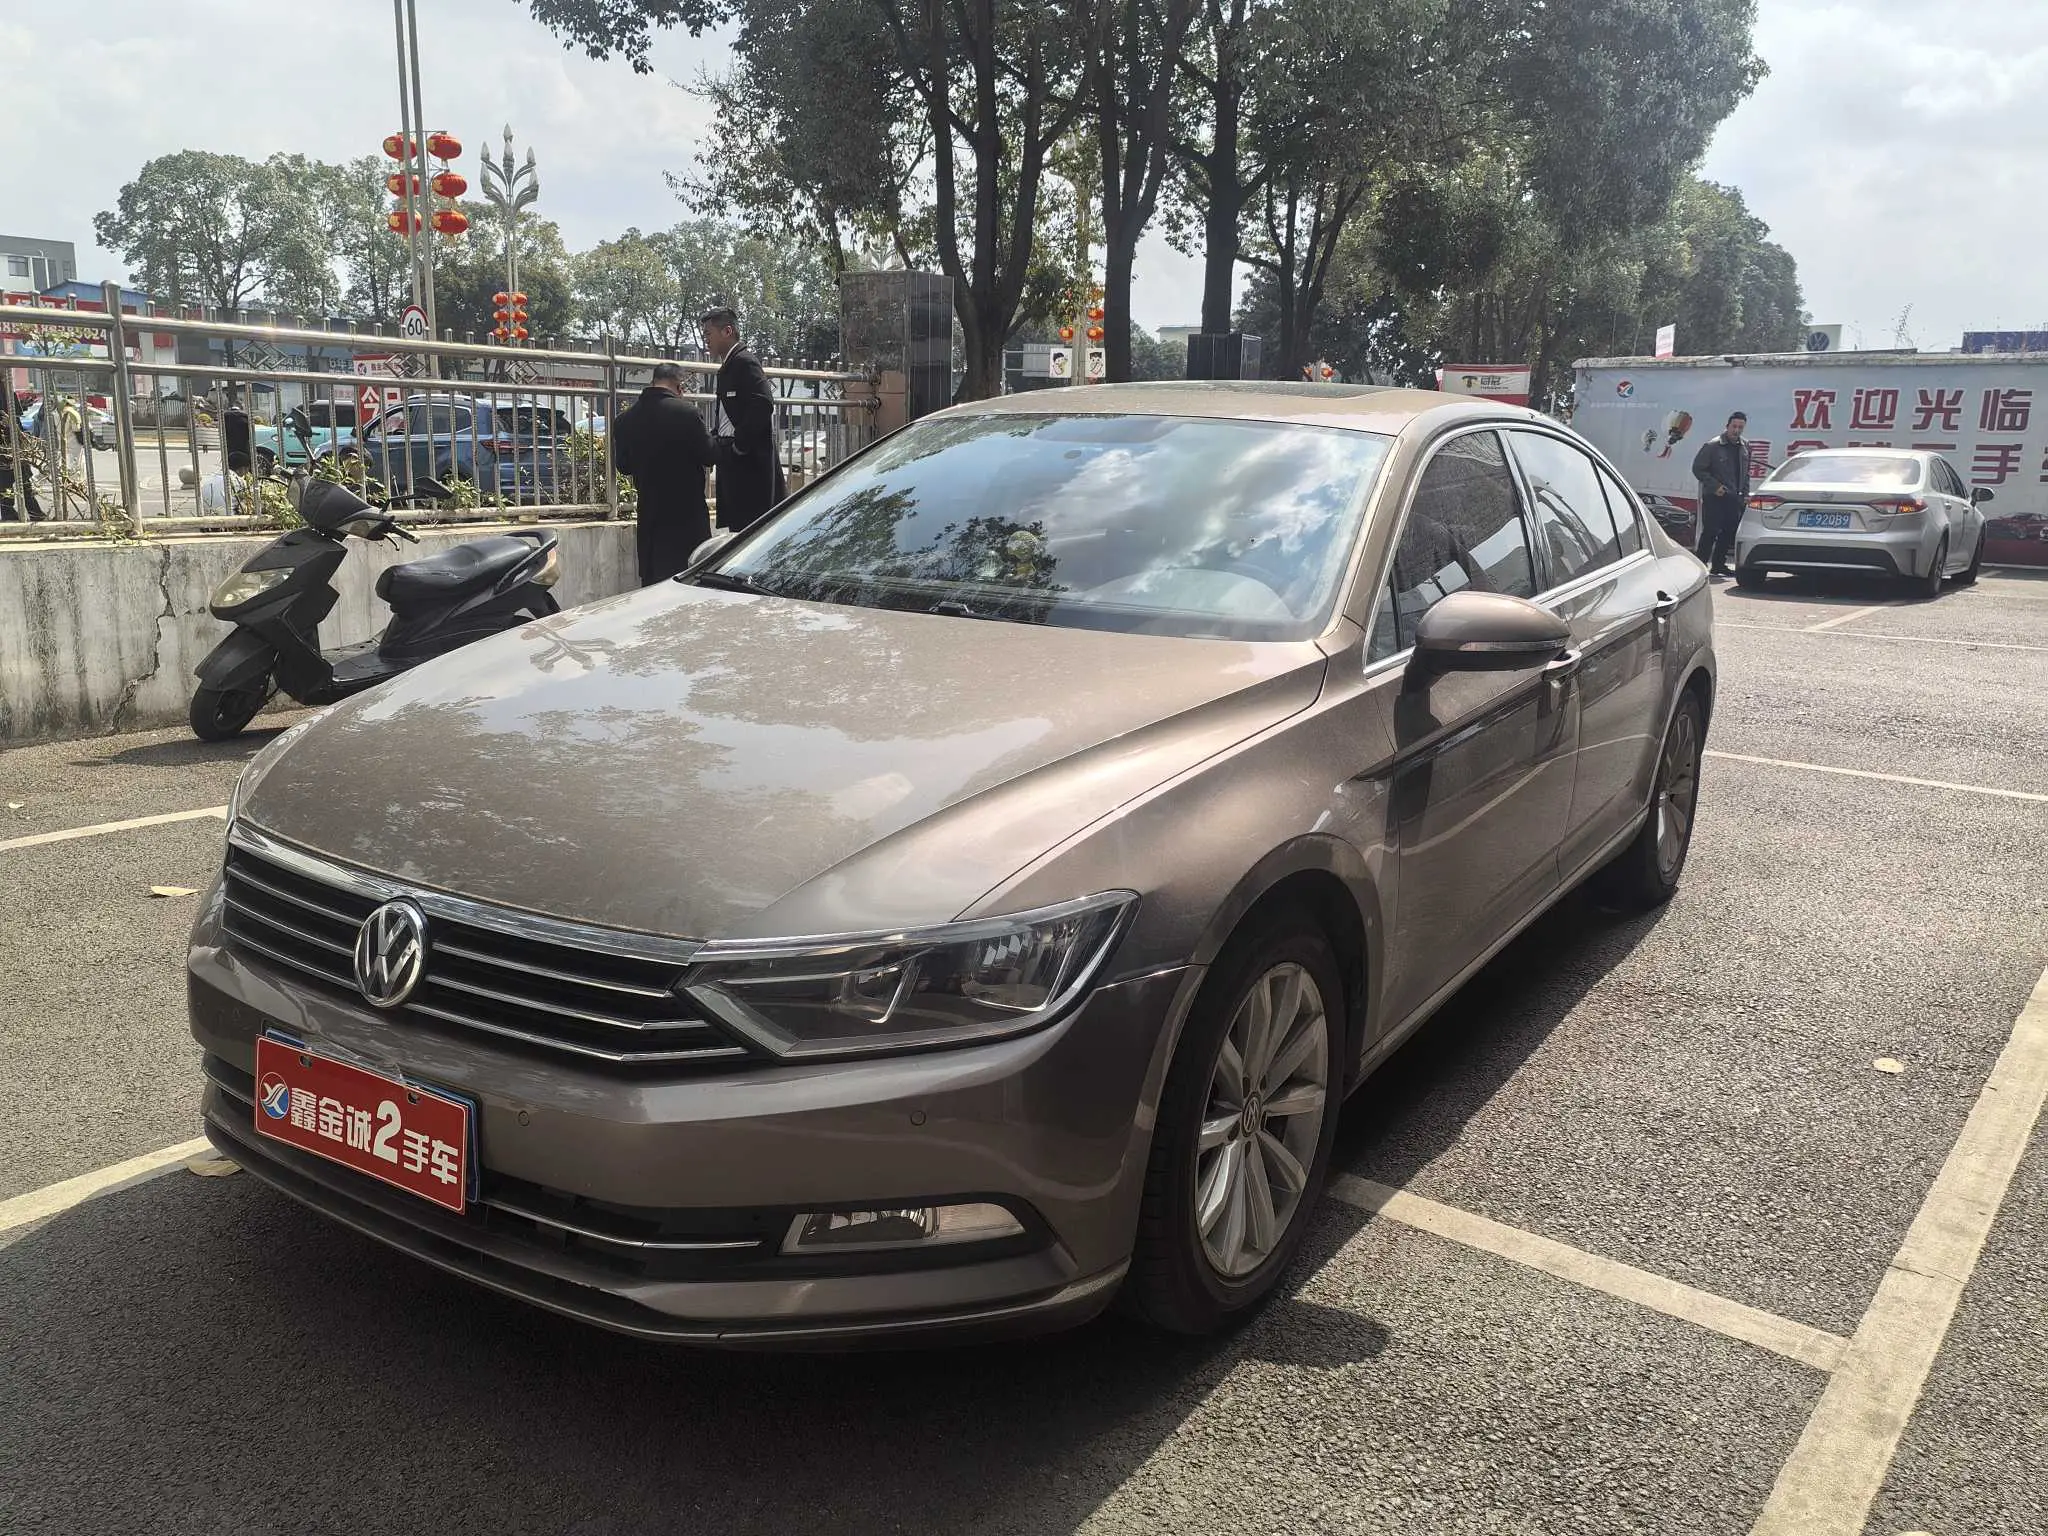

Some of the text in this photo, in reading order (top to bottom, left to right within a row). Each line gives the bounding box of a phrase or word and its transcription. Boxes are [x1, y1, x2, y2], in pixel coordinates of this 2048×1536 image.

[407, 318, 423, 336] 60
[1790, 388, 2032, 431] 欢迎光临
[290, 1087, 458, 1184] 鑫金诚2手车
